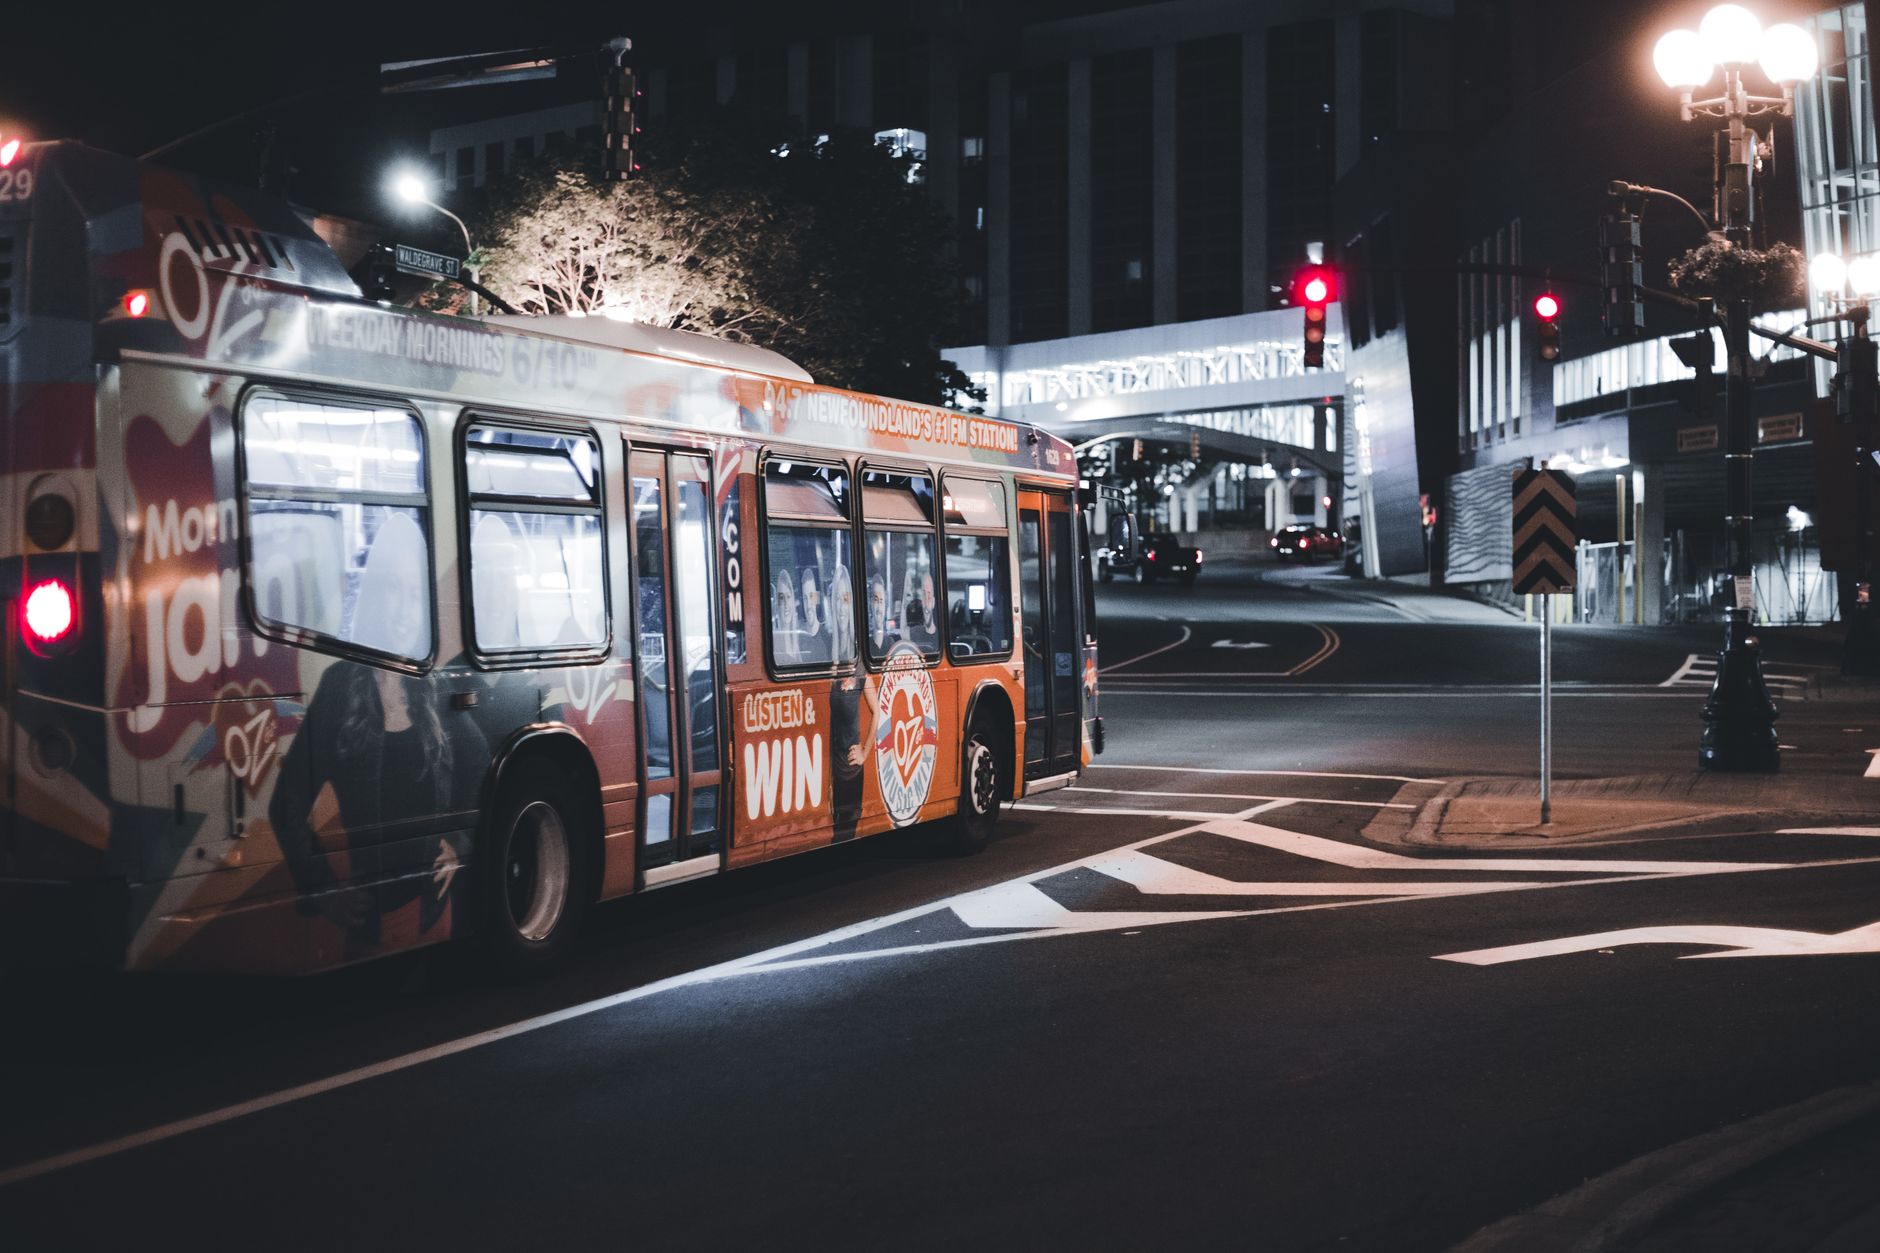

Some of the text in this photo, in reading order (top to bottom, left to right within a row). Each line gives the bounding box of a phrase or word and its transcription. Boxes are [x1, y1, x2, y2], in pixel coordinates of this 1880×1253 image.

[399, 248, 455, 274] WALDEGRAVE ST
[307, 305, 401, 356] WEEKDAY
[406, 322, 504, 373] MORNINGS
[511, 336, 577, 391] 6/10
[806, 391, 932, 441] NEWFOUNDLAND'S
[935, 411, 948, 443] #1
[950, 417, 967, 445] FM
[969, 420, 1019, 453] STATION!
[744, 689, 816, 733] LISTEN &
[744, 733, 822, 820] WIN
[913, 748, 932, 801] MIX
